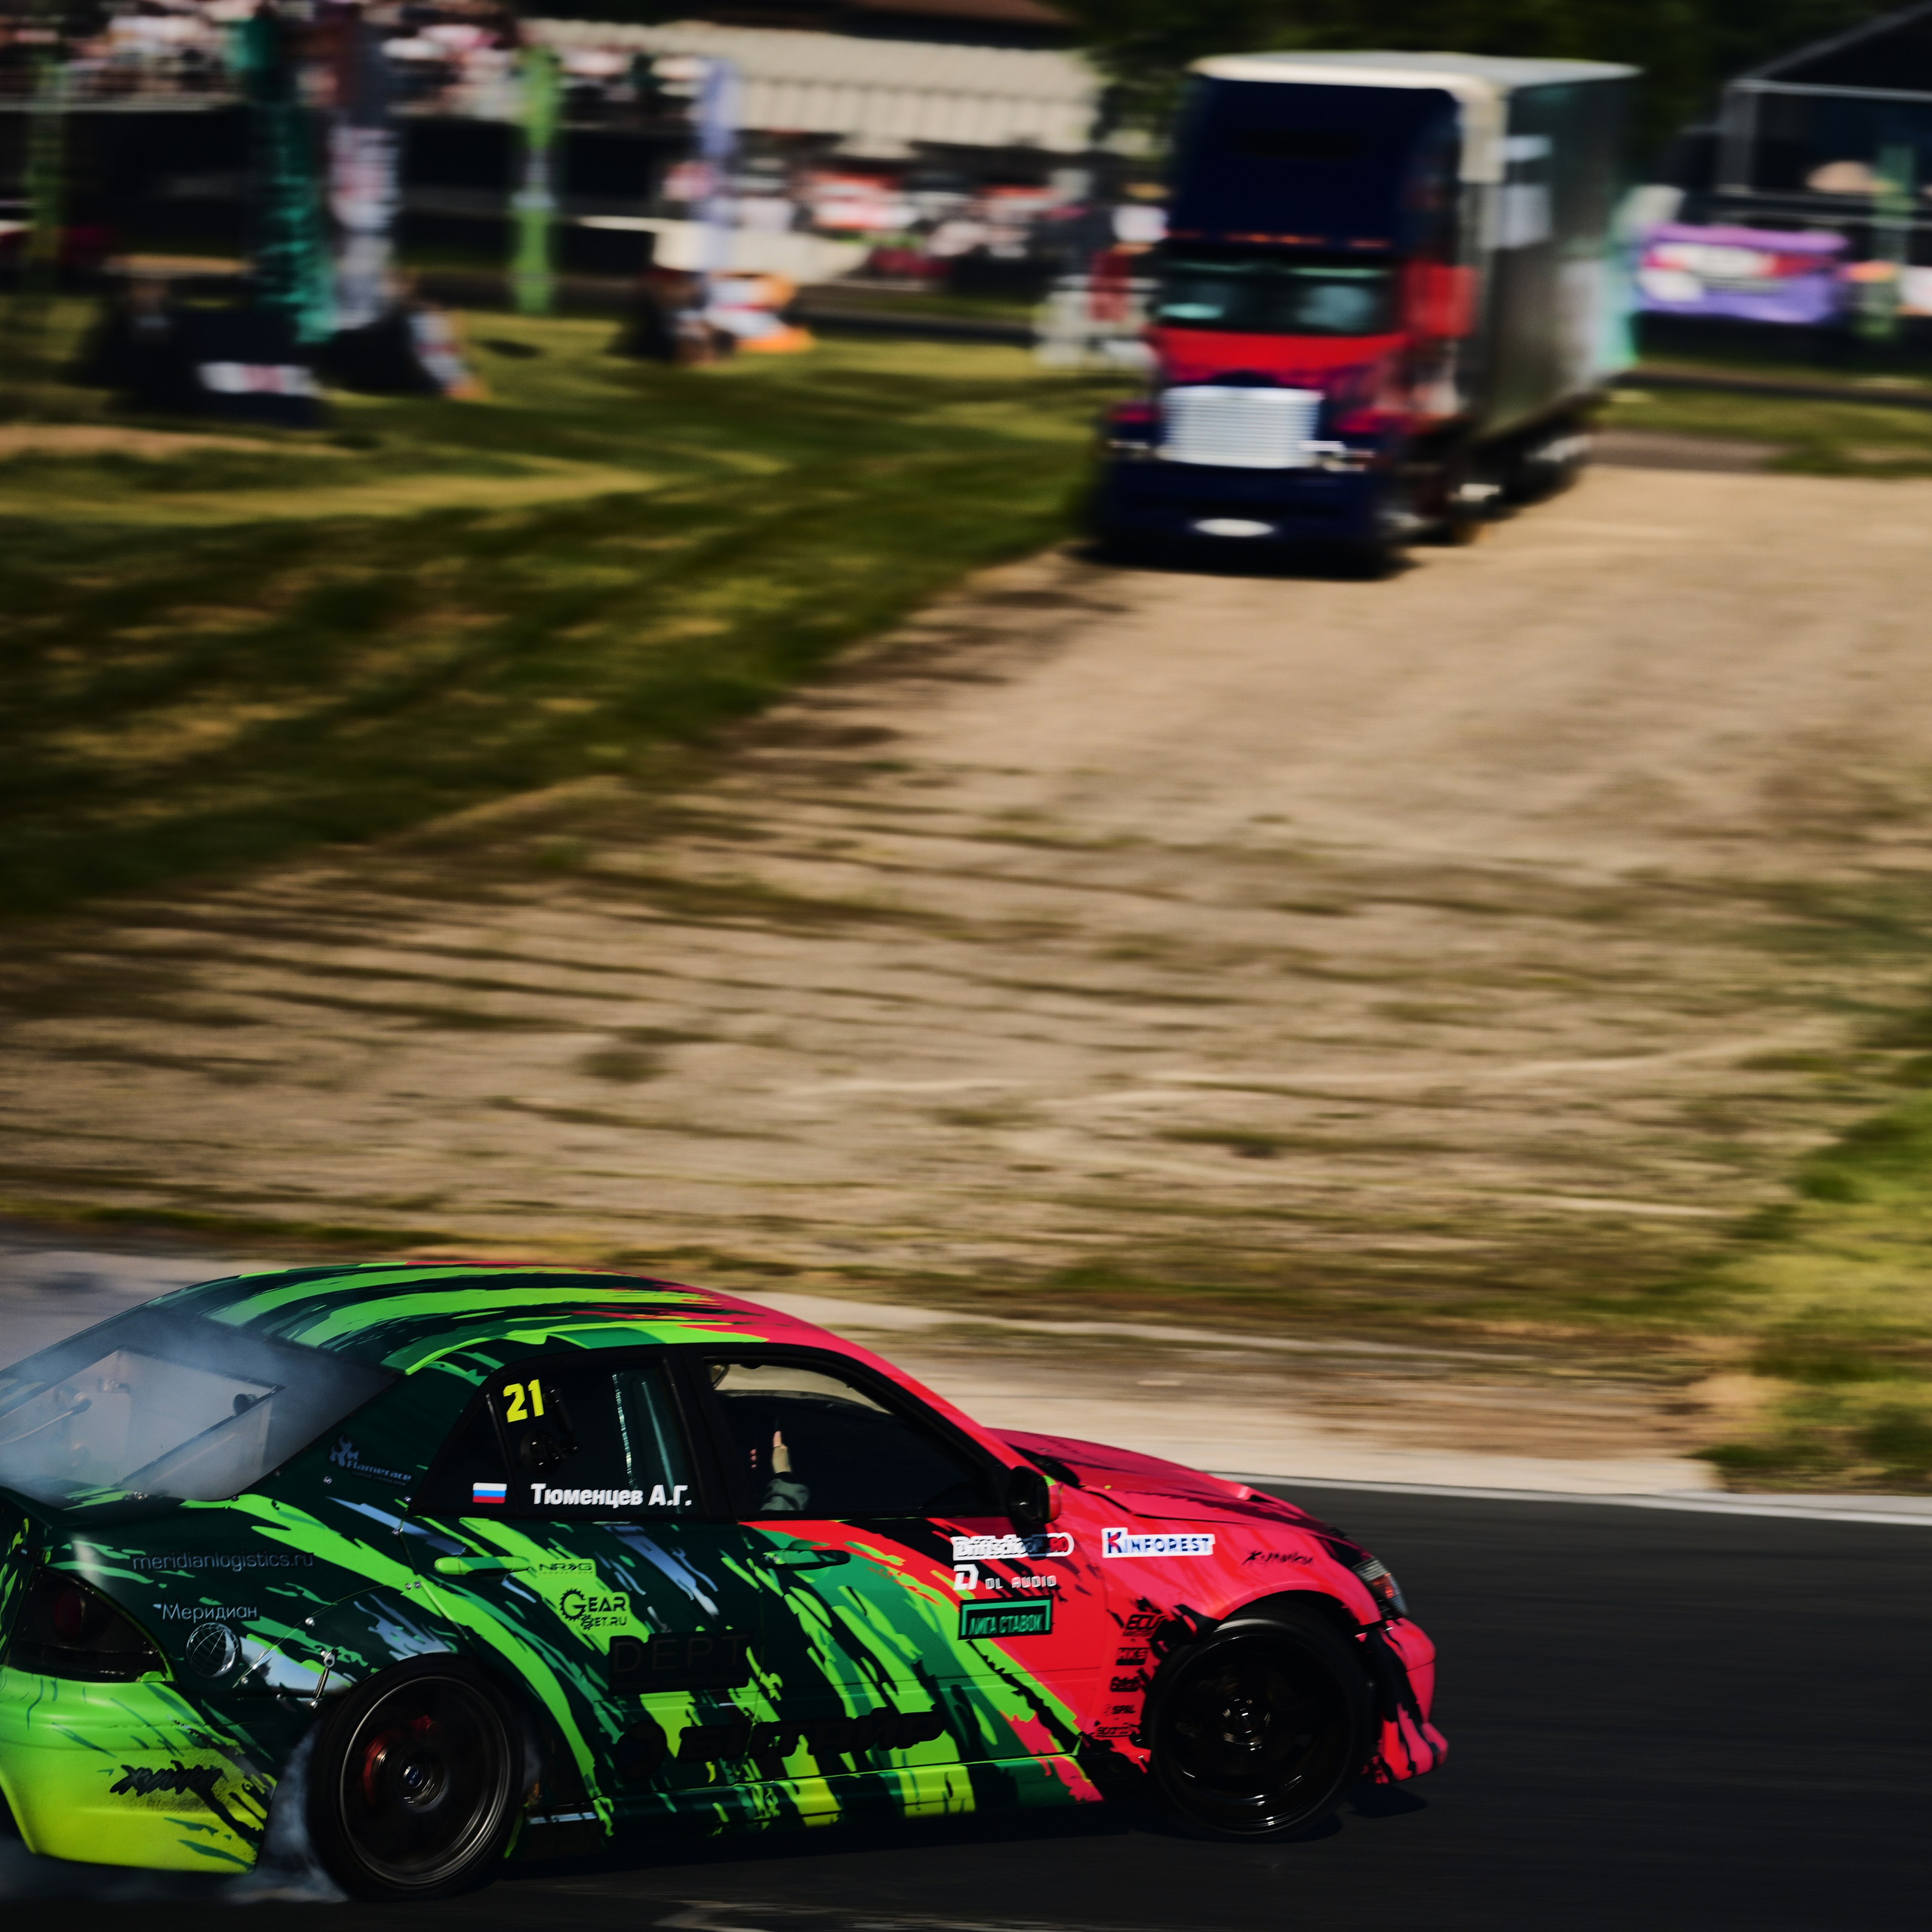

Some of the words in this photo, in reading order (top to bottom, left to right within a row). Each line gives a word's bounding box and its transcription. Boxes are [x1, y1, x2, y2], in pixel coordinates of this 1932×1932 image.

[503, 1379, 544, 1423] 21
[531, 1483, 643, 1509] Тюменцев
[648, 1484, 692, 1506] А.Г.
[133, 1551, 315, 1572] meridianlogistics.ru
[1011, 1574, 1057, 1589] AUDIO
[162, 1602, 258, 1623] Меридиан
[613, 1634, 751, 1674] DEPT
